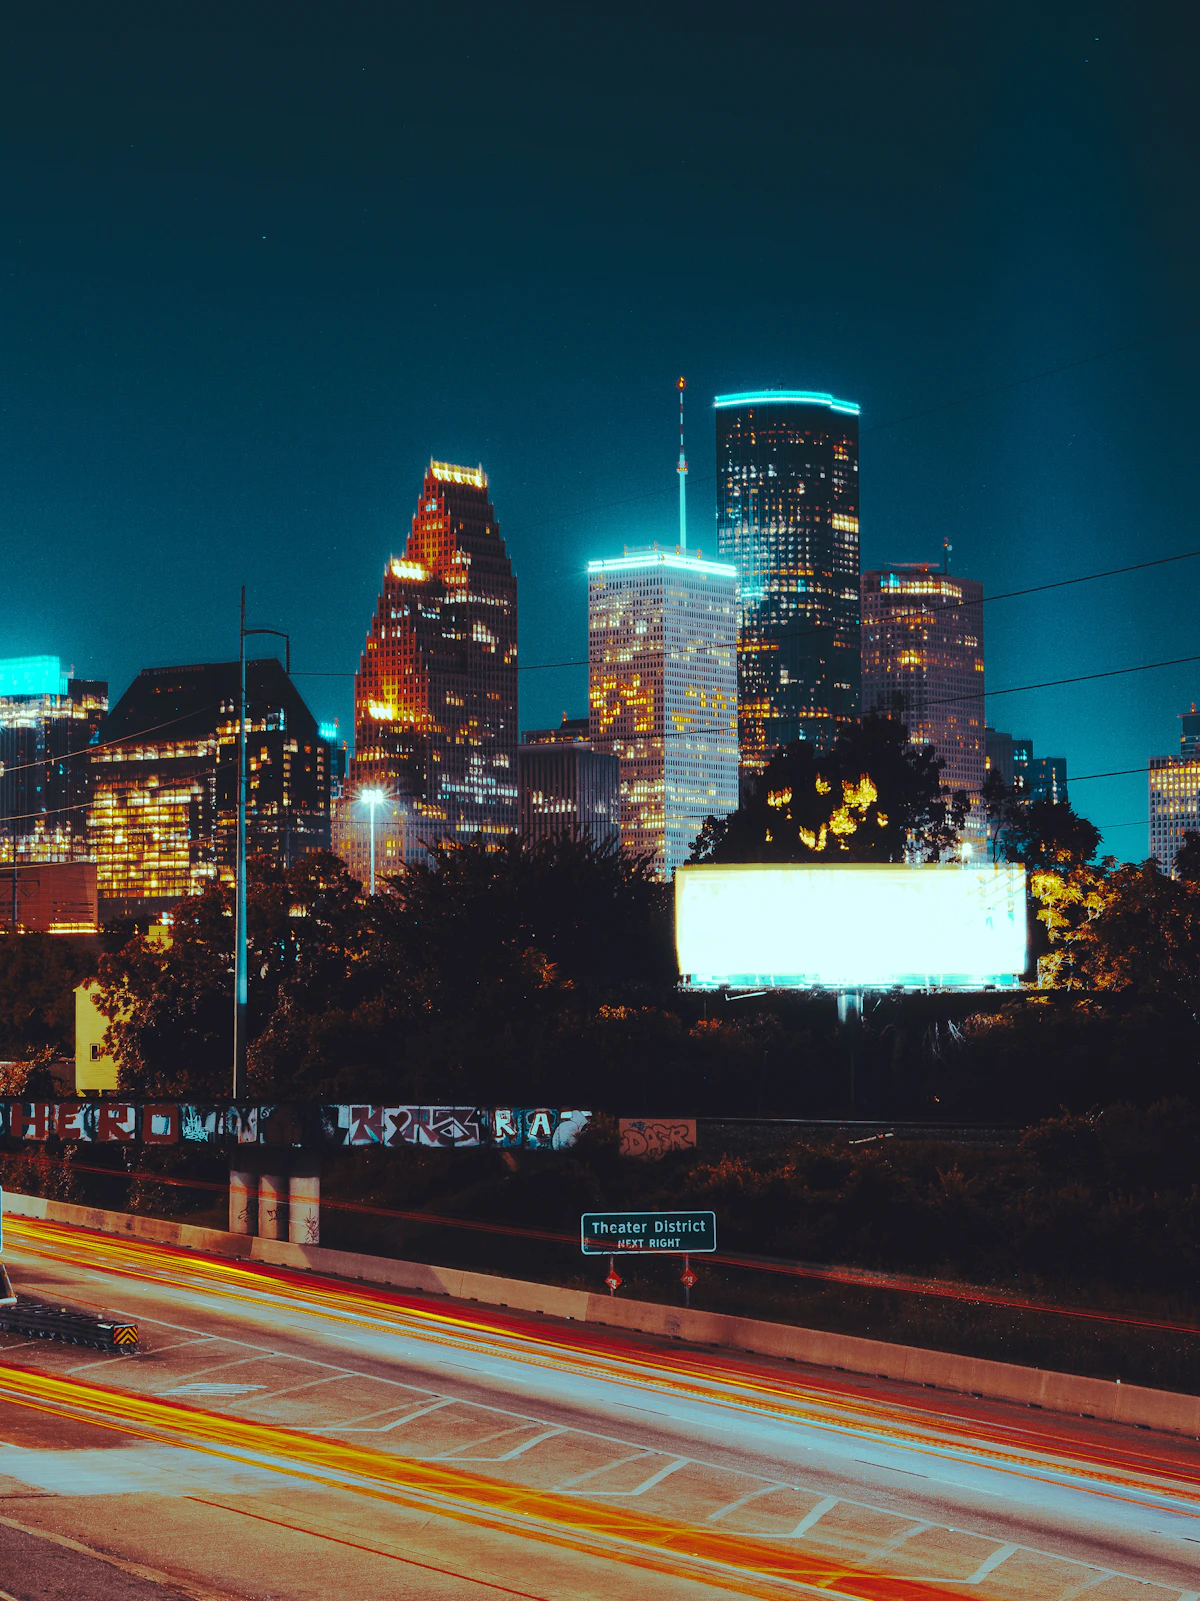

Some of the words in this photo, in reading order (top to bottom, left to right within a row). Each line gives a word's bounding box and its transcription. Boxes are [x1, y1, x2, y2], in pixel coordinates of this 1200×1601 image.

[591, 1221, 647, 1235] Theater
[654, 1219, 706, 1233] District
[617, 1238, 645, 1249] NEXT
[649, 1238, 681, 1248] RIGHT
